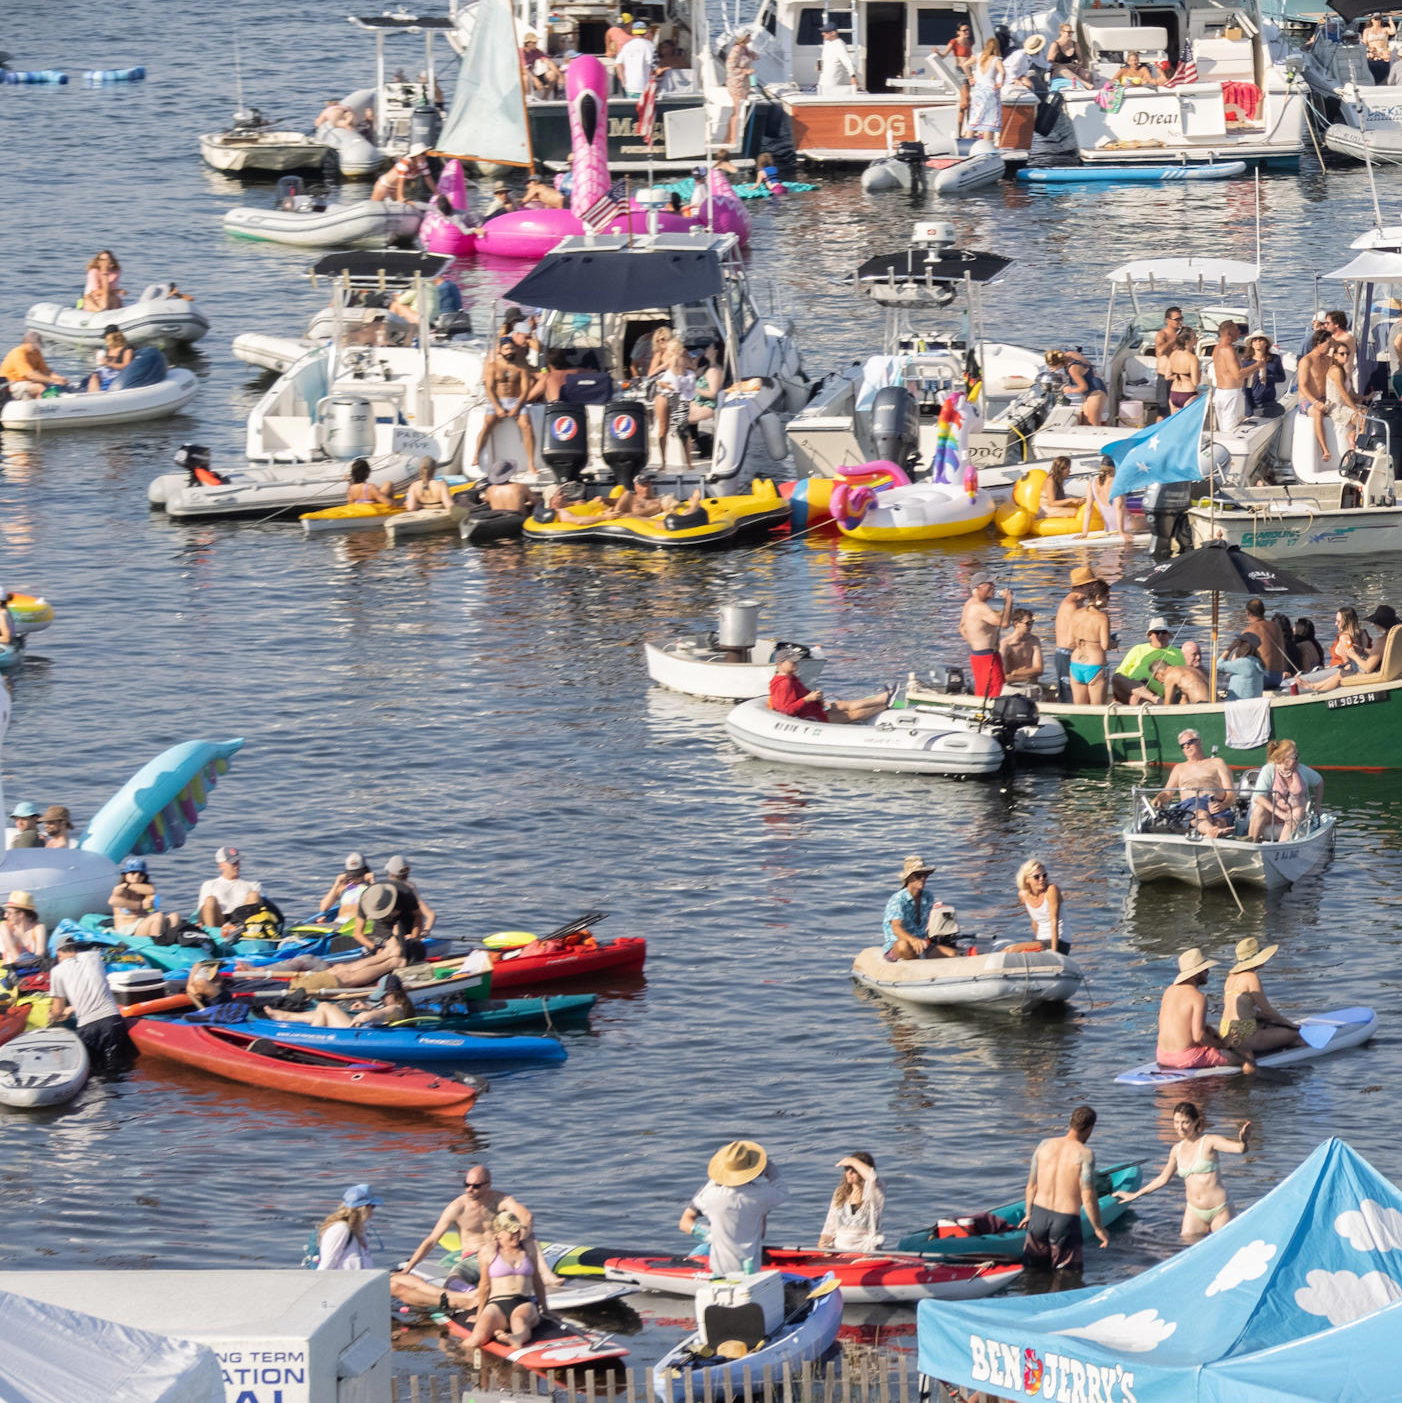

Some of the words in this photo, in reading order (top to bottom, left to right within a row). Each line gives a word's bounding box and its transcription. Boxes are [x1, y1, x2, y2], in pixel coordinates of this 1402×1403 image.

[844, 114, 906, 136] DOG
[1368, 693, 1375, 702] H
[216, 1352, 242, 1363] NG
[250, 1352, 304, 1363] TERM
[222, 1368, 304, 1385] ATION
[970, 1334, 1022, 1391] BEN
[1043, 1351, 1137, 1402] JERRY'S
